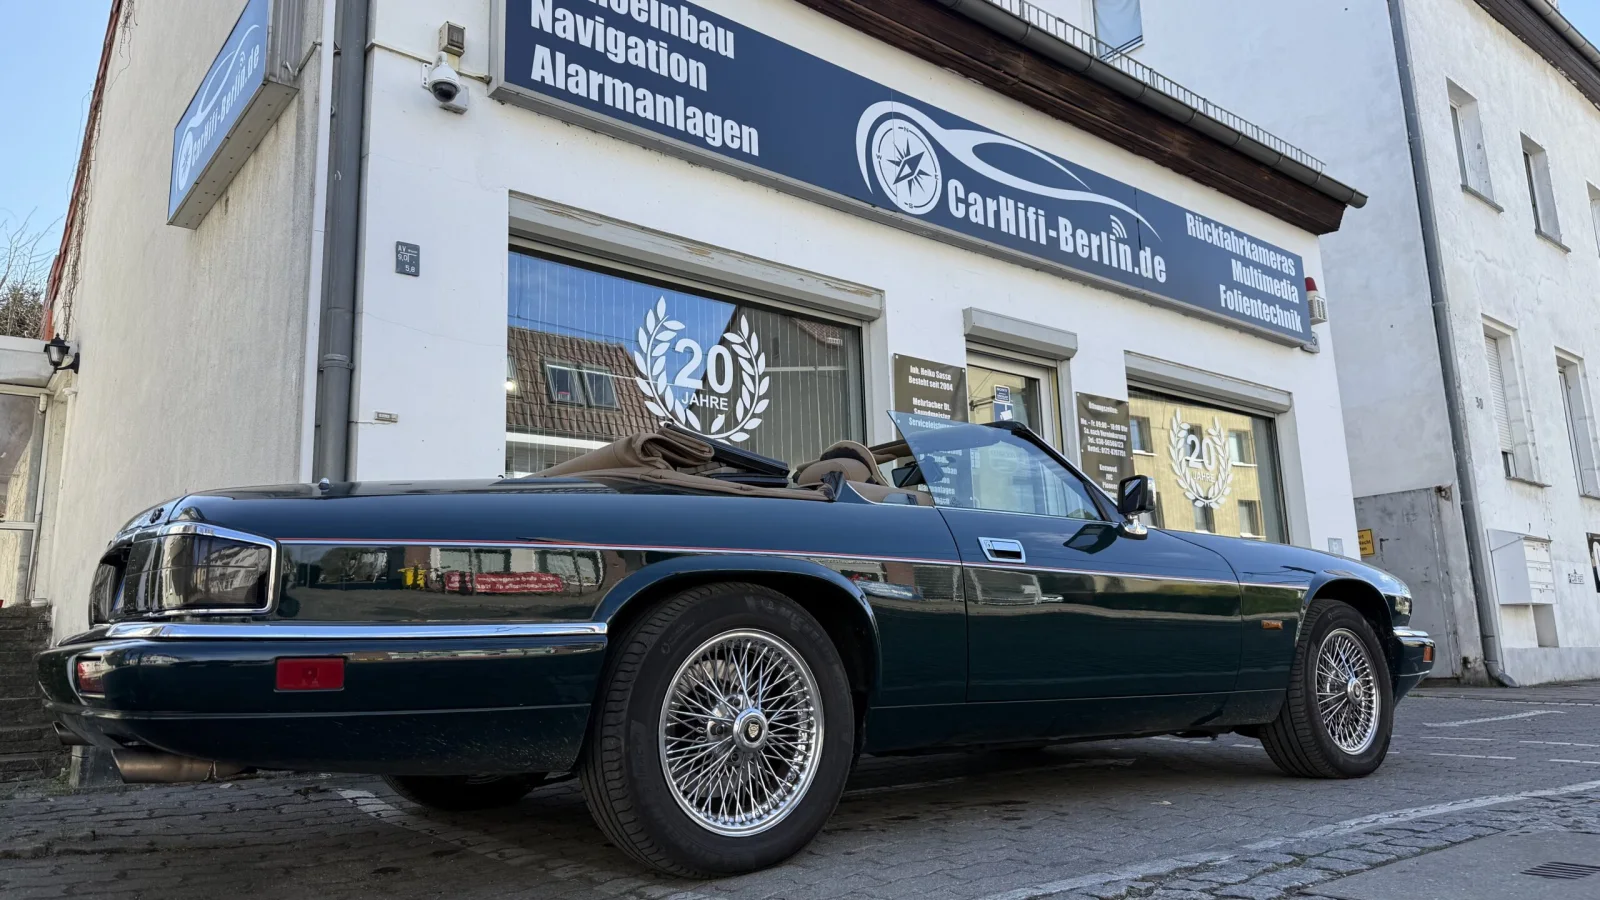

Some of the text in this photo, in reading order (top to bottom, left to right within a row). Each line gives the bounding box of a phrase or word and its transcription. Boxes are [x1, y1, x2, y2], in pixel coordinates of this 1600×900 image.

[531, 0, 708, 92] Navigation
[530, 44, 759, 157] Alarmanlagen
[948, 178, 1166, 284] CarHifi-Berlin.de
[1186, 212, 1296, 276] Rückfahrkameras
[1231, 258, 1300, 304] Multimedia
[1219, 284, 1303, 333] Folientechnik
[674, 338, 734, 394] 20
[908, 376, 929, 386] Besteht
[930, 380, 940, 389] seit
[920, 367, 936, 378] Heiko
[682, 392, 728, 410] JAHRE
[1187, 434, 1216, 471] 20
[1192, 472, 1215, 482] JAHRE
